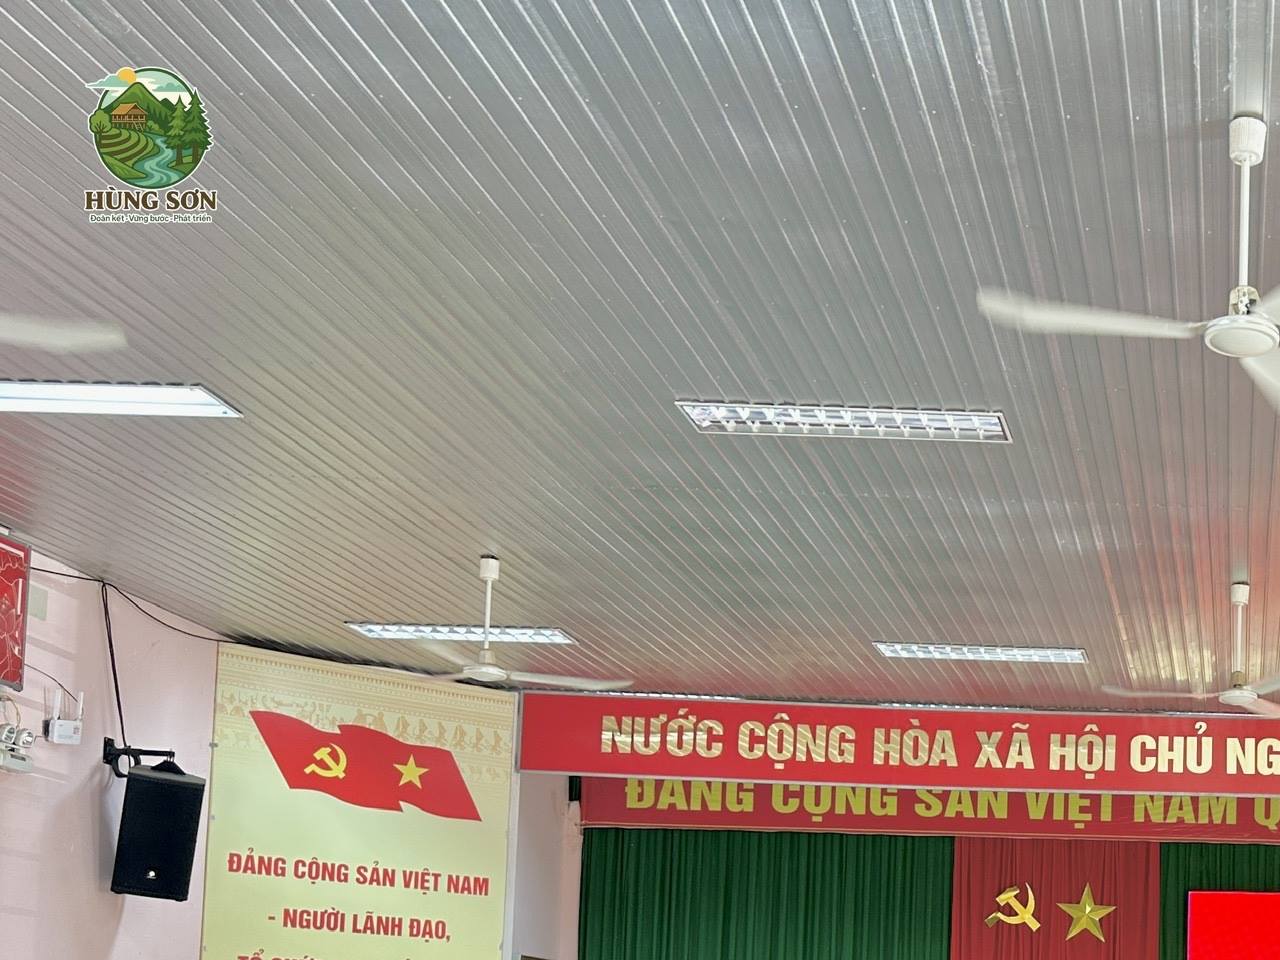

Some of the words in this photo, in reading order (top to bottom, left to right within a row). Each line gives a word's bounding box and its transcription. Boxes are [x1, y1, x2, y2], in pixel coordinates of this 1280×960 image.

[600, 708, 724, 757] NƯỚC
[738, 713, 856, 770] CỘNG
[873, 719, 958, 767] HÒA
[974, 722, 1035, 770] XÃ
[1049, 724, 1116, 779] HỘI
[1130, 722, 1213, 774] CHỦ
[1134, 793, 1238, 825] NAM
[227, 847, 286, 877] ĐẢNG
[294, 857, 349, 884] CỘNG
[356, 861, 395, 887] SẢN
[402, 868, 441, 895] VIỆT
[447, 874, 489, 896] NAM
[282, 907, 345, 932] NGƯỜI
[352, 911, 402, 936] LÃNH
[409, 919, 451, 943] ĐẠO,
